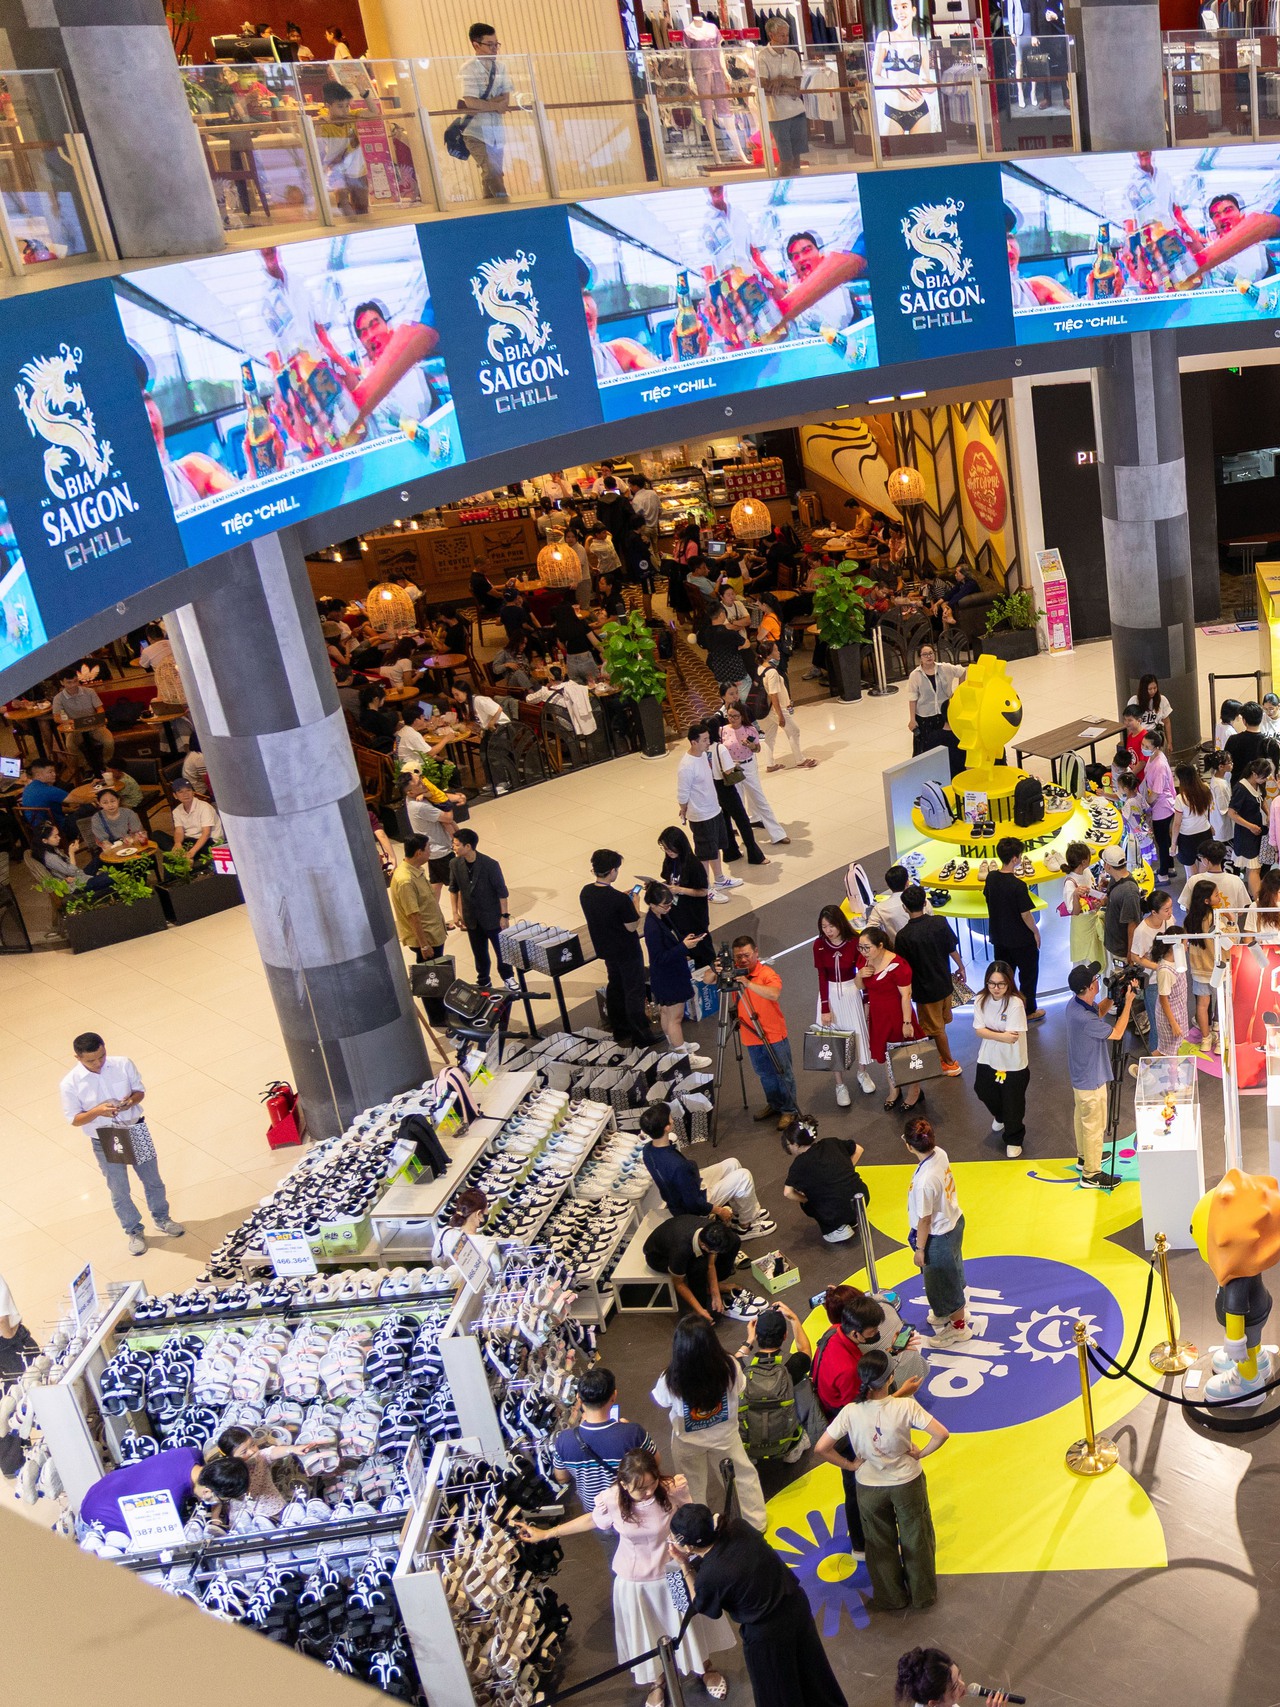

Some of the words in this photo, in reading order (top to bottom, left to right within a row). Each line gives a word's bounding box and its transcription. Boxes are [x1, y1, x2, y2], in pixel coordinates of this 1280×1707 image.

[926, 274, 951, 289] BIA
[912, 310, 973, 331] CHILL
[1054, 318, 1084, 334] TIỆC
[504, 344, 532, 362] BIA
[495, 385, 558, 414] CHILL
[640, 385, 671, 403] TIỆC
[64, 471, 95, 499] BIA
[220, 512, 253, 535] TIỆC
[64, 526, 132, 571] CHILL
